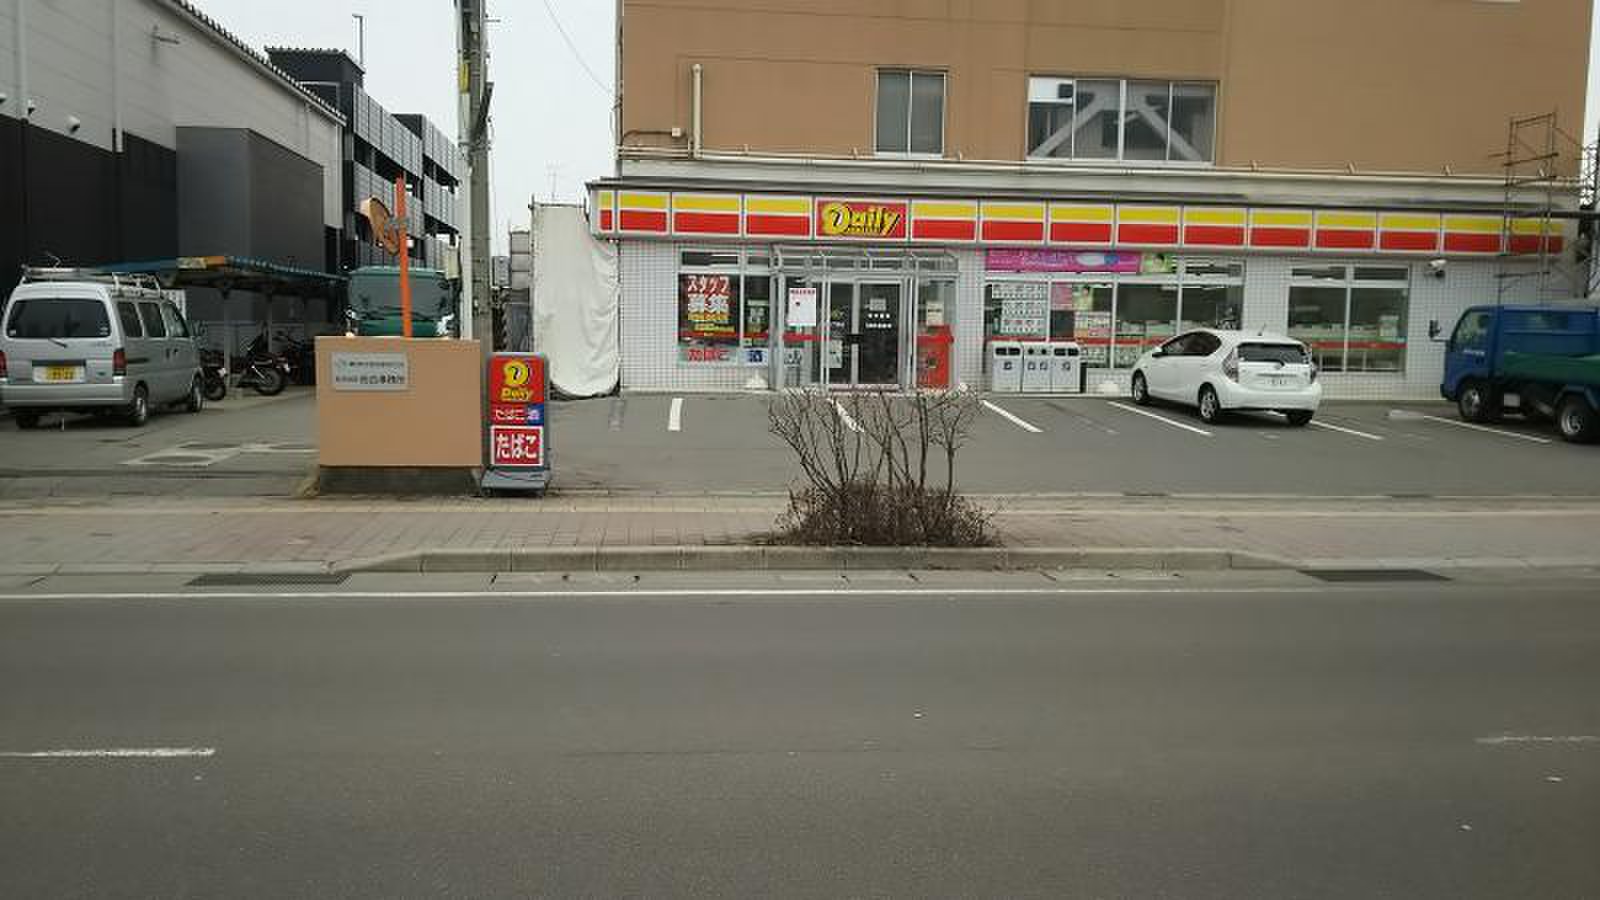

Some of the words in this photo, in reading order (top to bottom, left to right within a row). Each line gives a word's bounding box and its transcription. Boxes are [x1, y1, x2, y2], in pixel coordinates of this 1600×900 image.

[821, 202, 901, 235] Daily
[495, 433, 538, 459] たばこ
